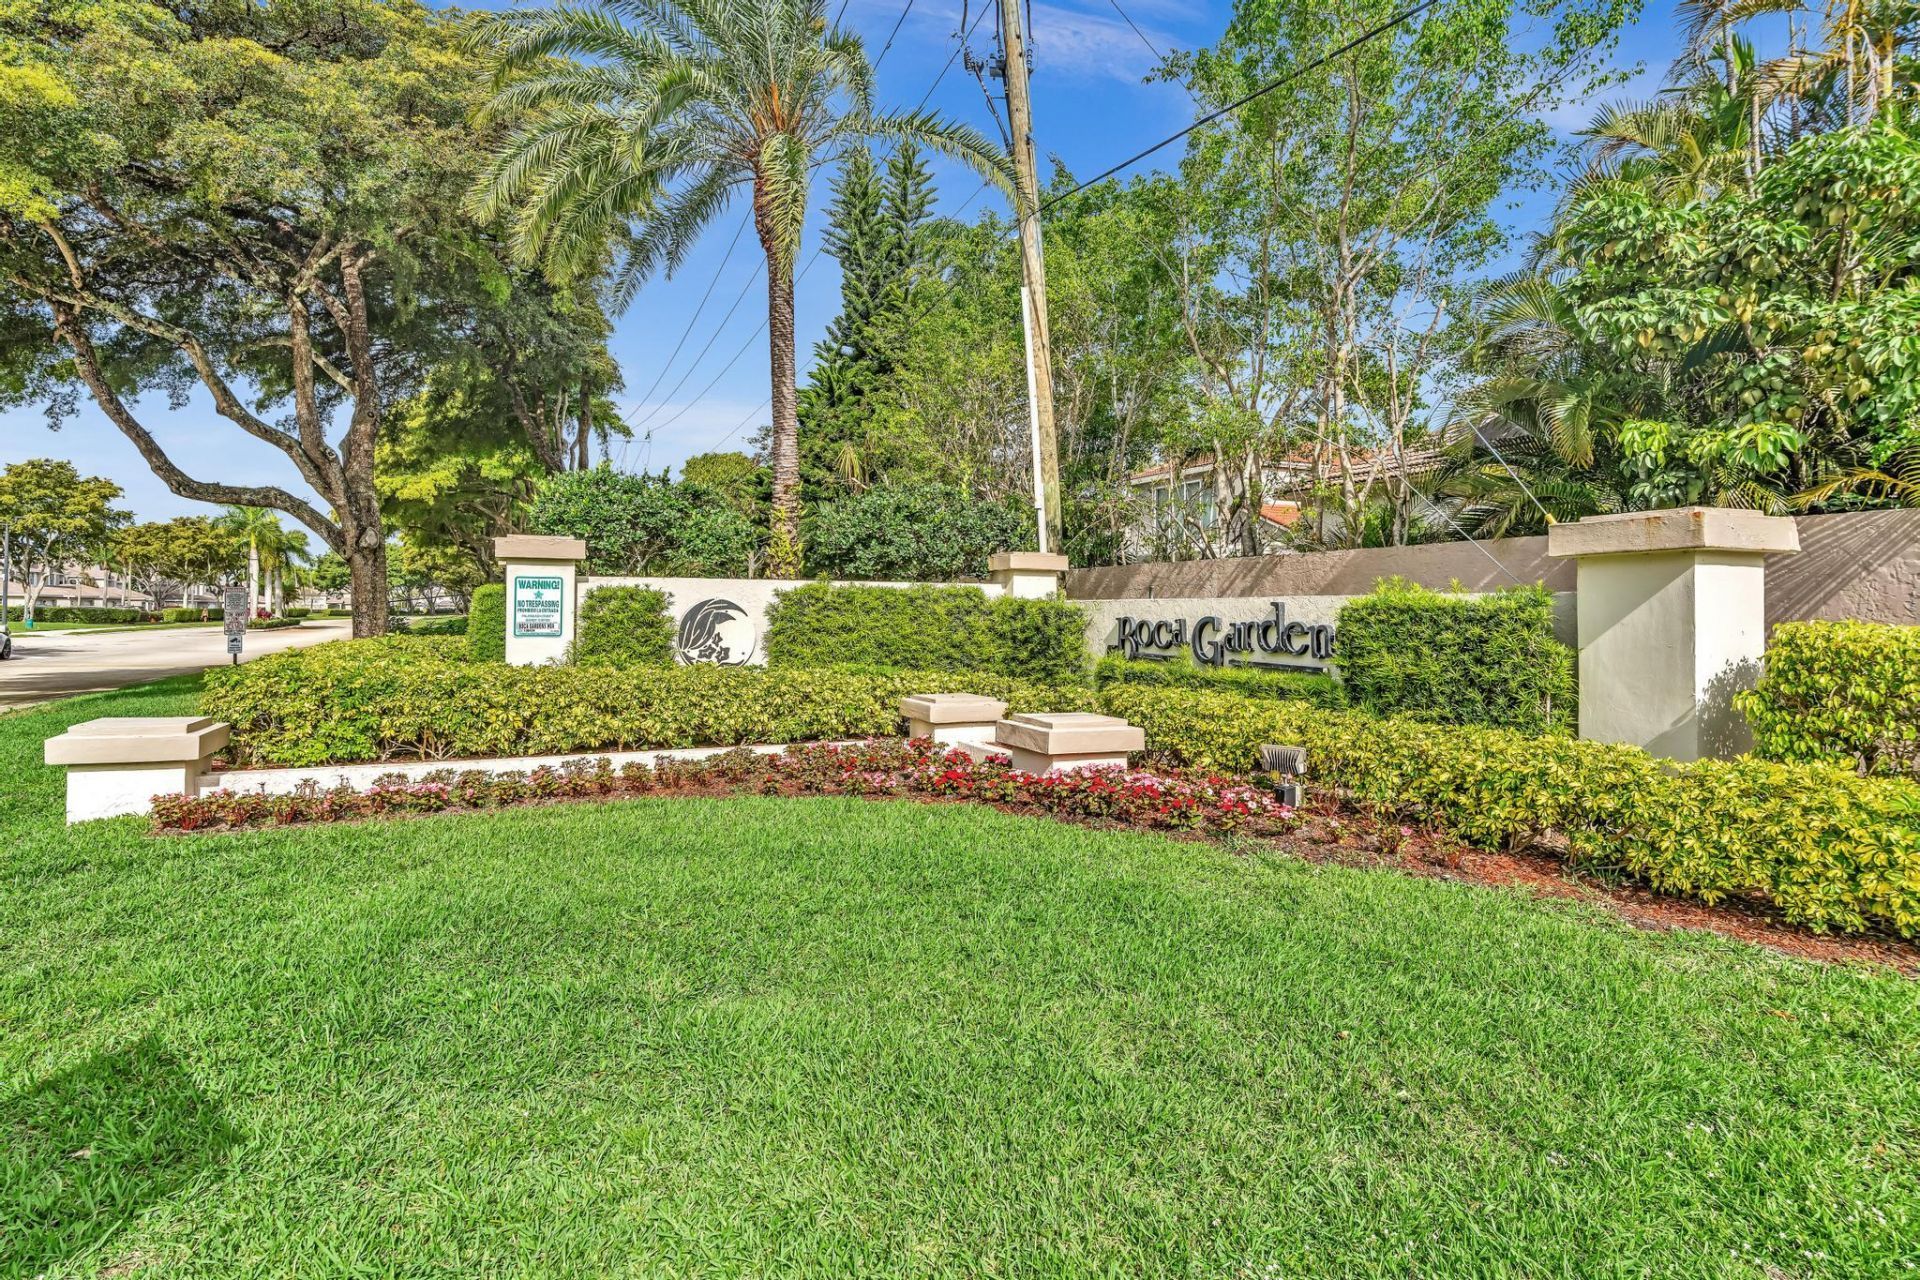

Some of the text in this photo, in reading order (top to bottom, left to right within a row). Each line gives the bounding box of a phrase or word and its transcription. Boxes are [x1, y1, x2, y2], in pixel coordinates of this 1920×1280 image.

[518, 580, 560, 590] WARNING!
[517, 600, 560, 608] NO TRESPASSING
[1108, 616, 1191, 661] Boca
